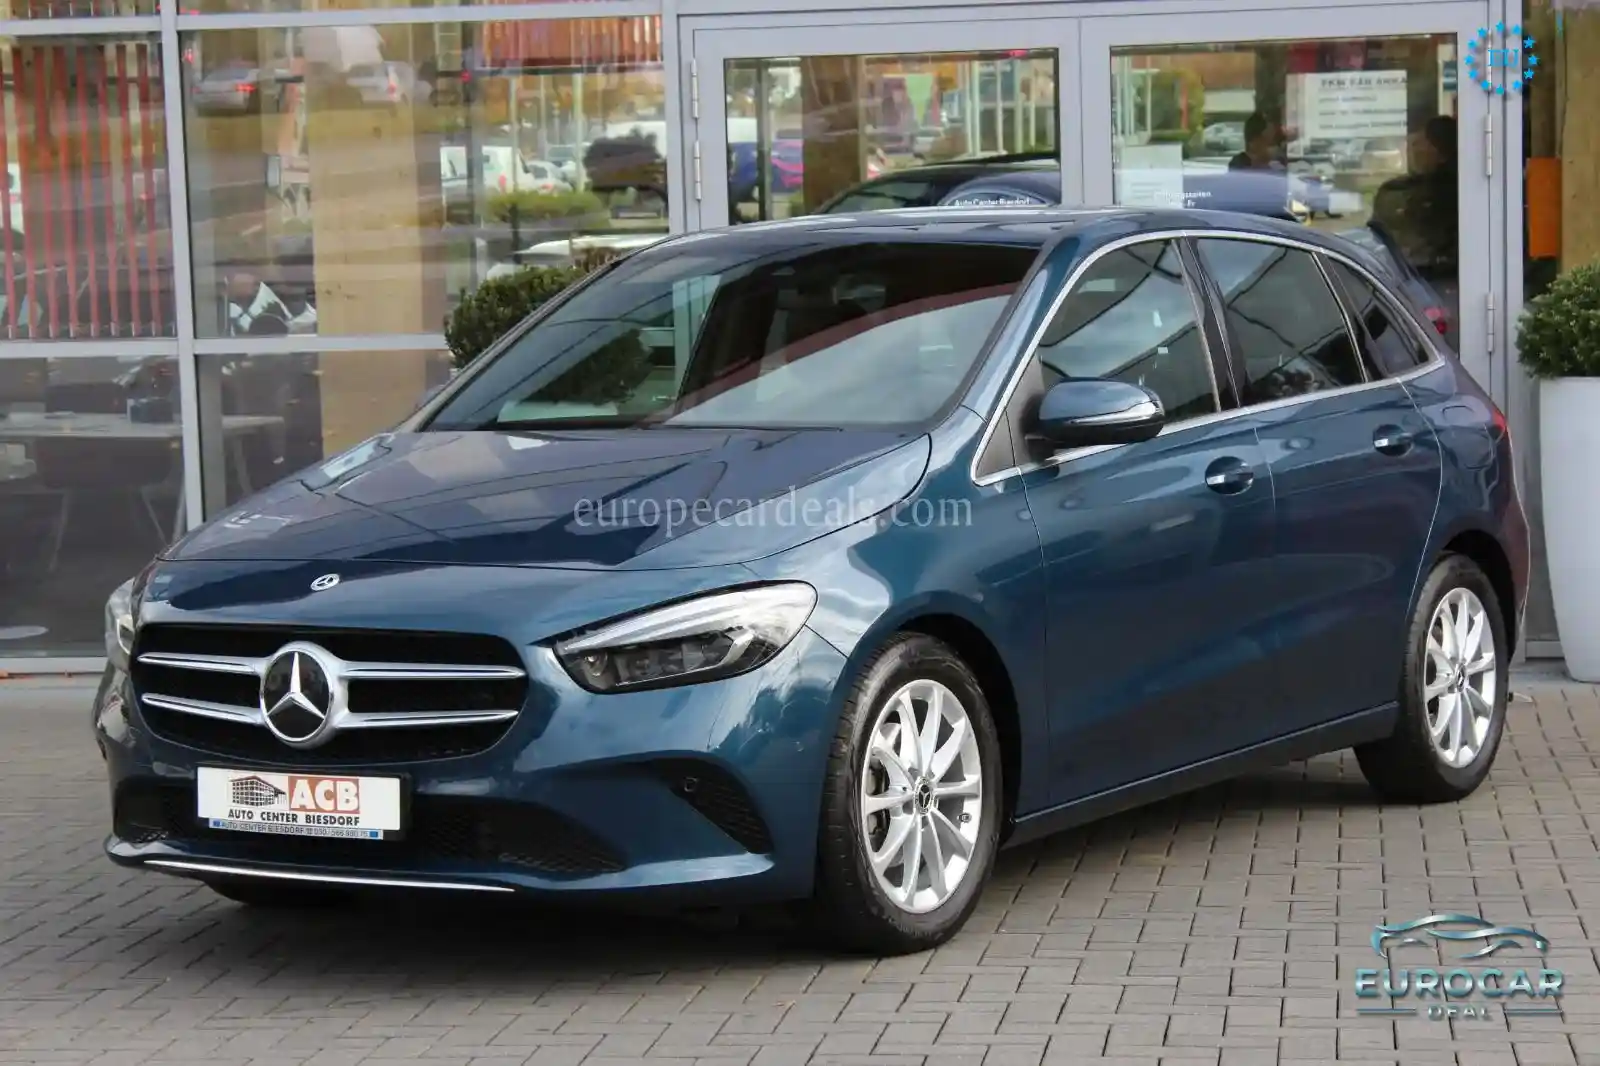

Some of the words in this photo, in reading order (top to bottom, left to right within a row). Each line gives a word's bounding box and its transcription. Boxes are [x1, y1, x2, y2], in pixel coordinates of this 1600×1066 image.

[290, 779, 360, 812] ACB
[227, 808, 254, 821] AUTO
[260, 811, 299, 824] CENTER
[305, 814, 361, 827] BIESDORF
